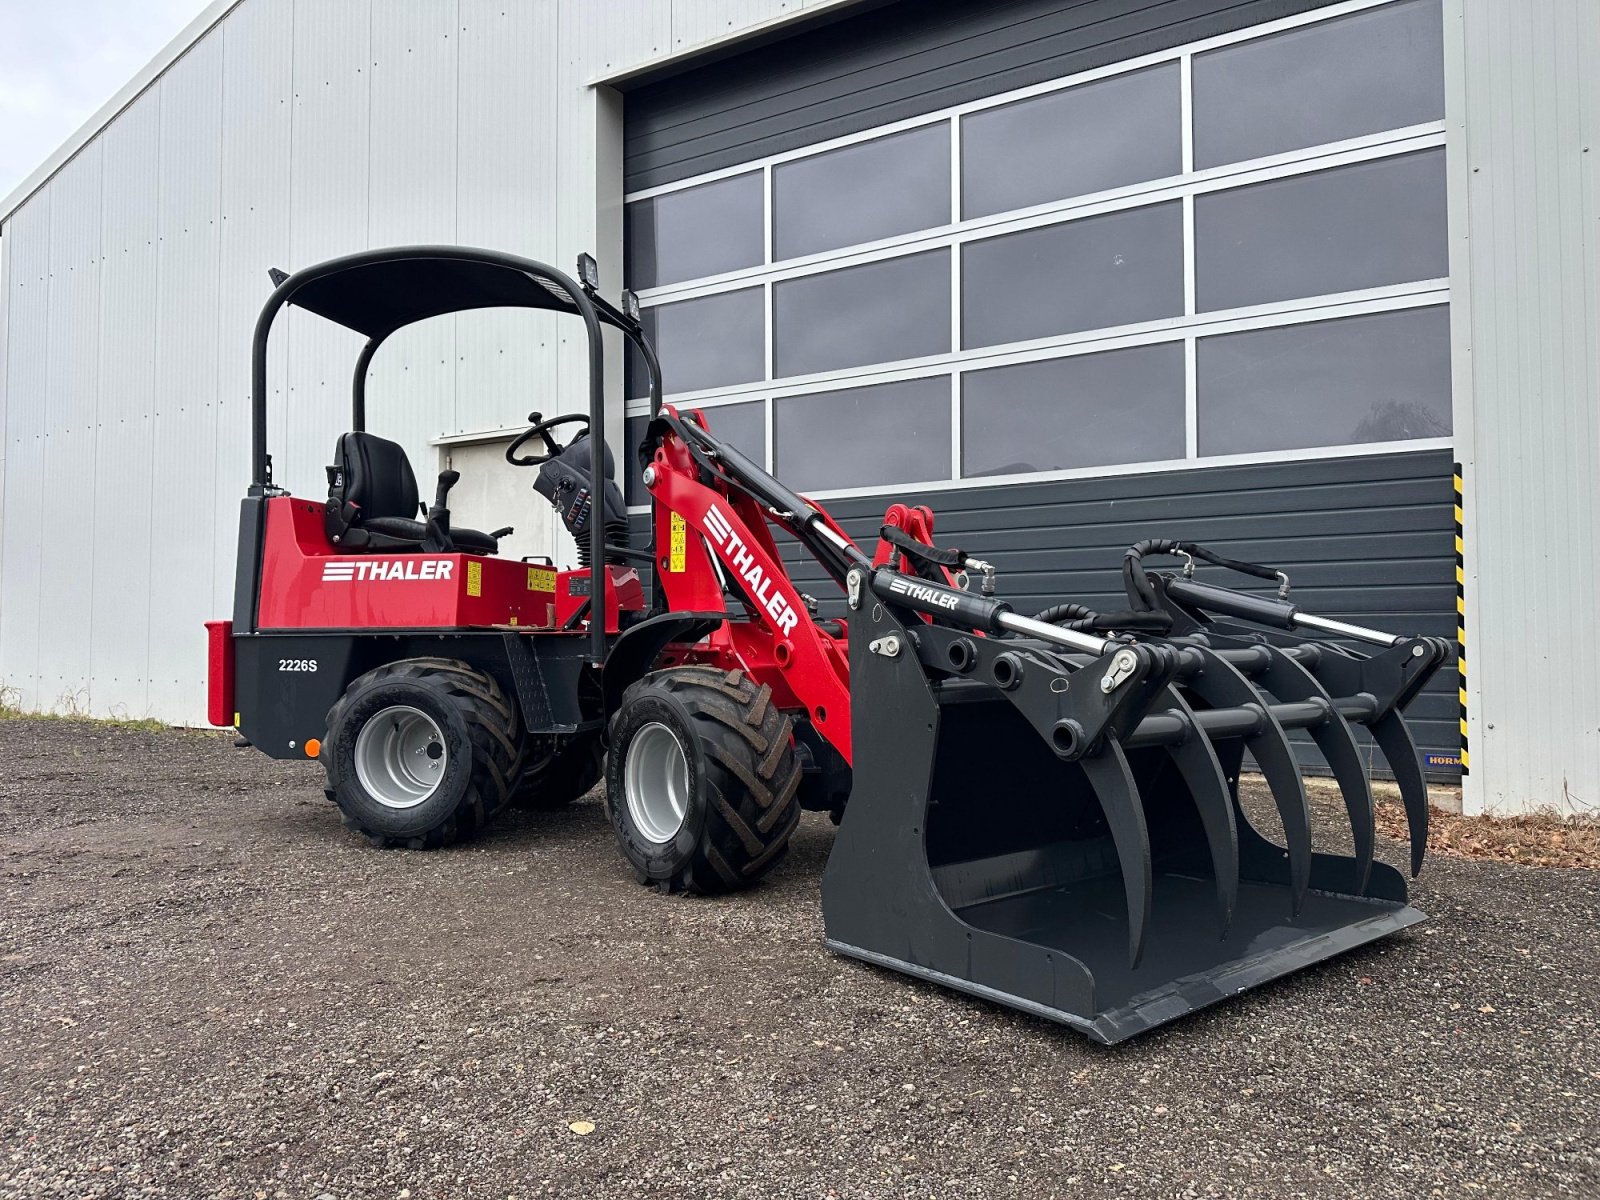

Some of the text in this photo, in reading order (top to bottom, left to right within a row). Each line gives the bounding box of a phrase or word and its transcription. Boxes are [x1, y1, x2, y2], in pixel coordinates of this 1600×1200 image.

[356, 560, 454, 581] THALER
[726, 530, 798, 638] THALER
[907, 584, 959, 610] THALER
[279, 659, 318, 672] 2226S
